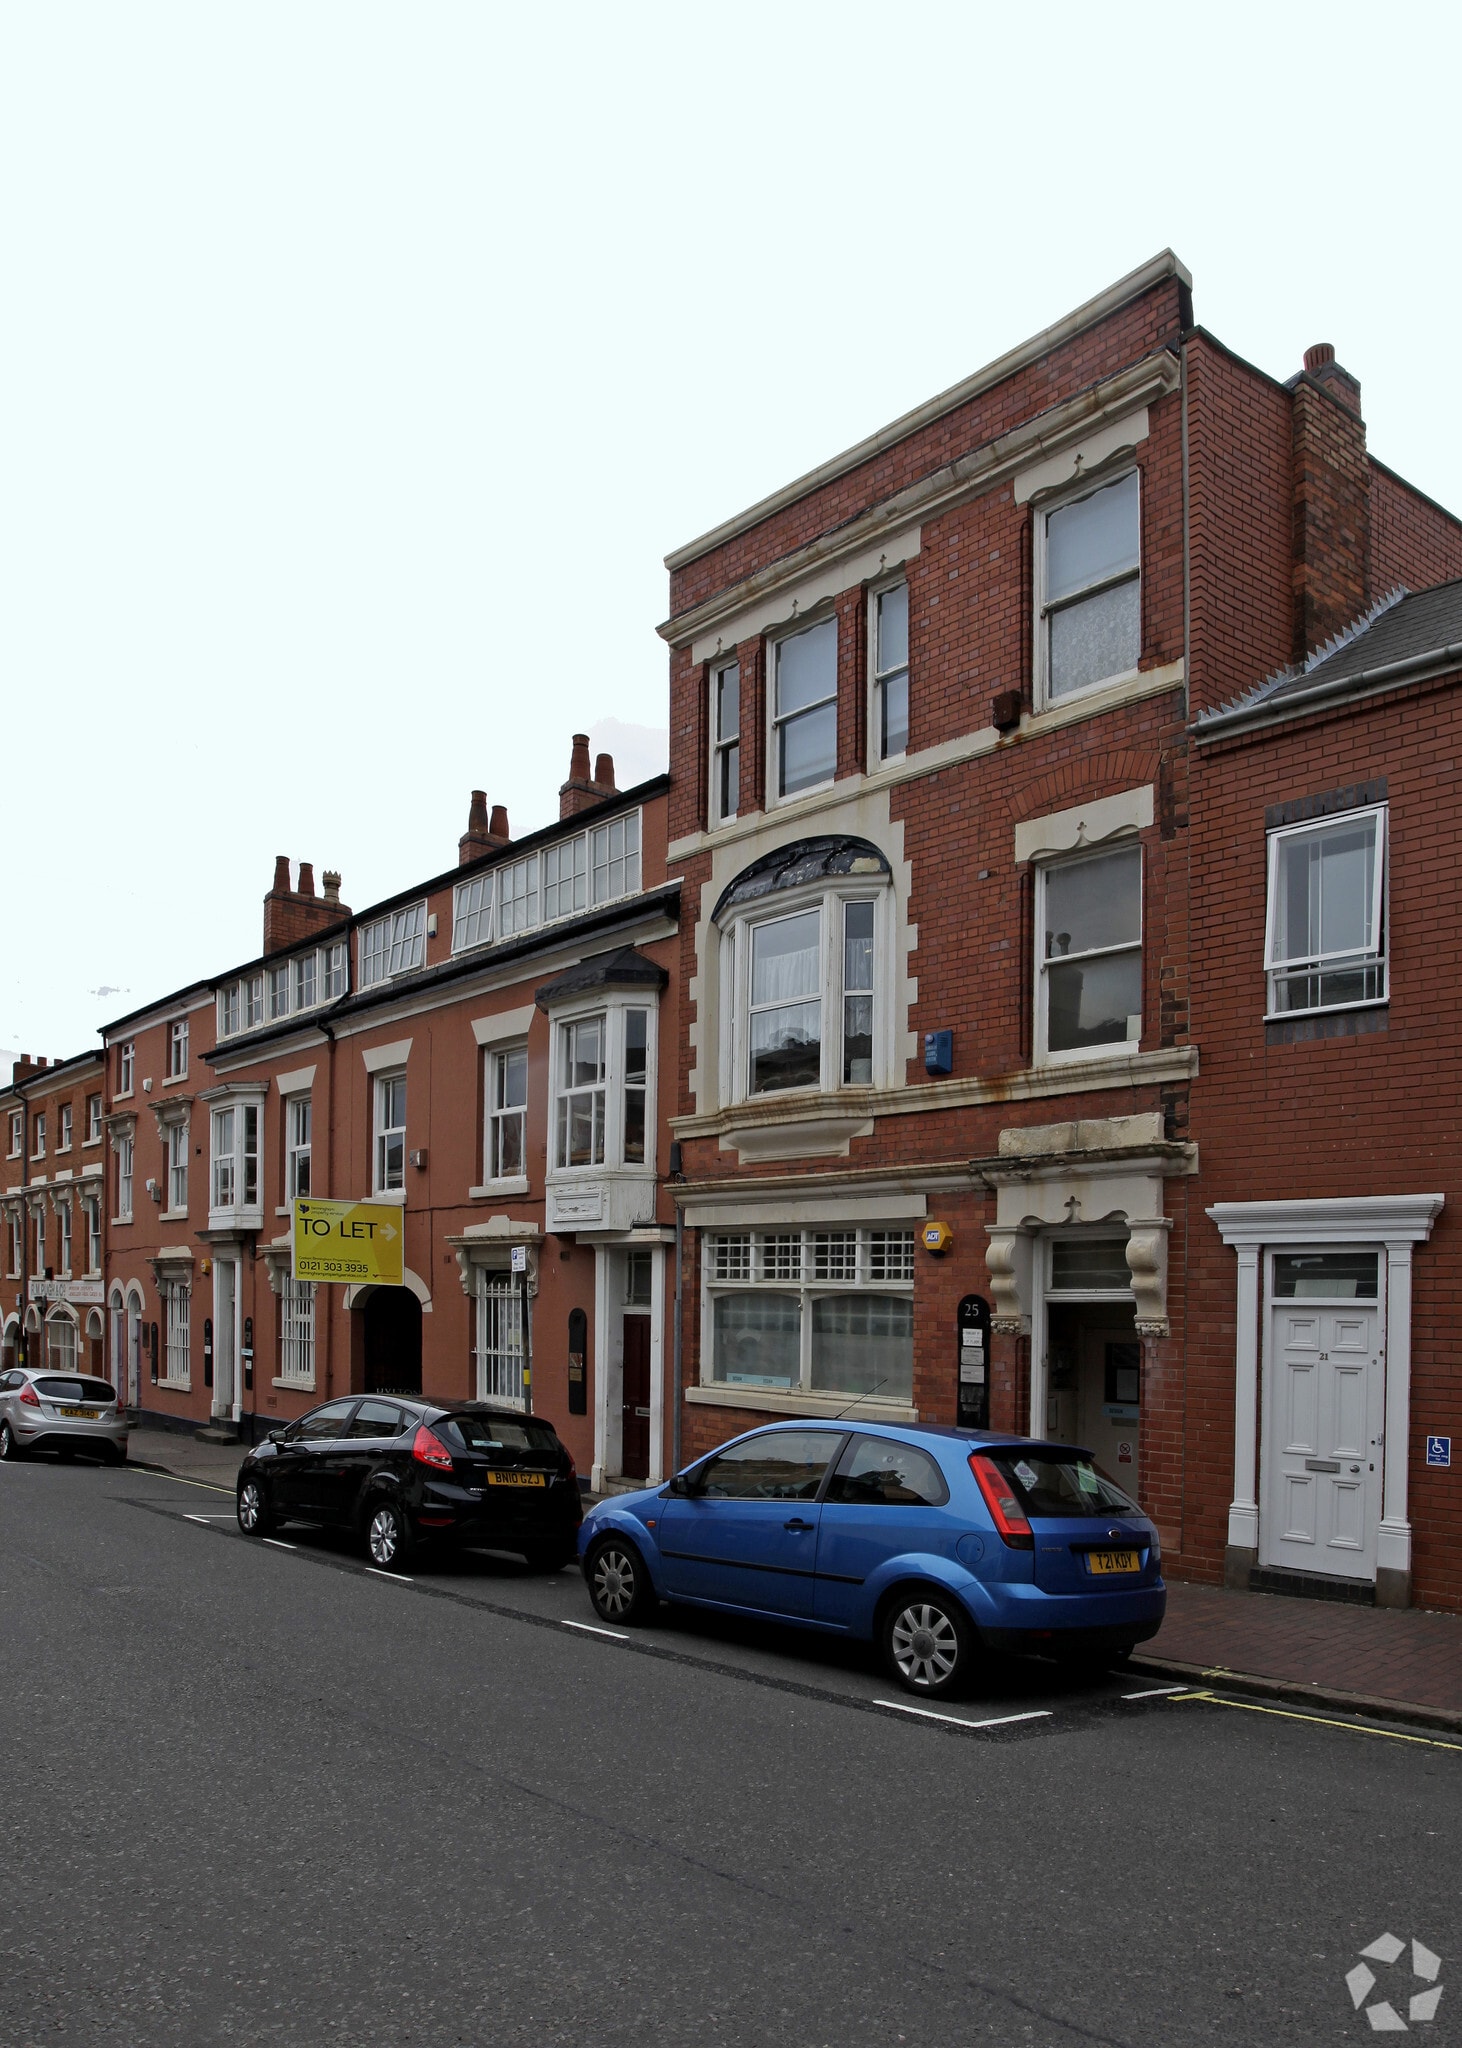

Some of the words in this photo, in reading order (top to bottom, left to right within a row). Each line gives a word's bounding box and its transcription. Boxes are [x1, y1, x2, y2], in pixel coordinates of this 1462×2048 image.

[299, 1218, 330, 1236] TO
[340, 1221, 378, 1239] LET
[927, 1232, 939, 1240] ADT
[299, 1261, 320, 1270] 0121
[324, 1262, 342, 1272] 303
[345, 1264, 369, 1273] 3935
[964, 1304, 979, 1317] 25
[1319, 1352, 1328, 1360] 21
[495, 1473, 518, 1483] BN10
[521, 1473, 540, 1484] GZJ
[1096, 1552, 1114, 1570] T21
[1115, 1552, 1132, 1568] KDY
